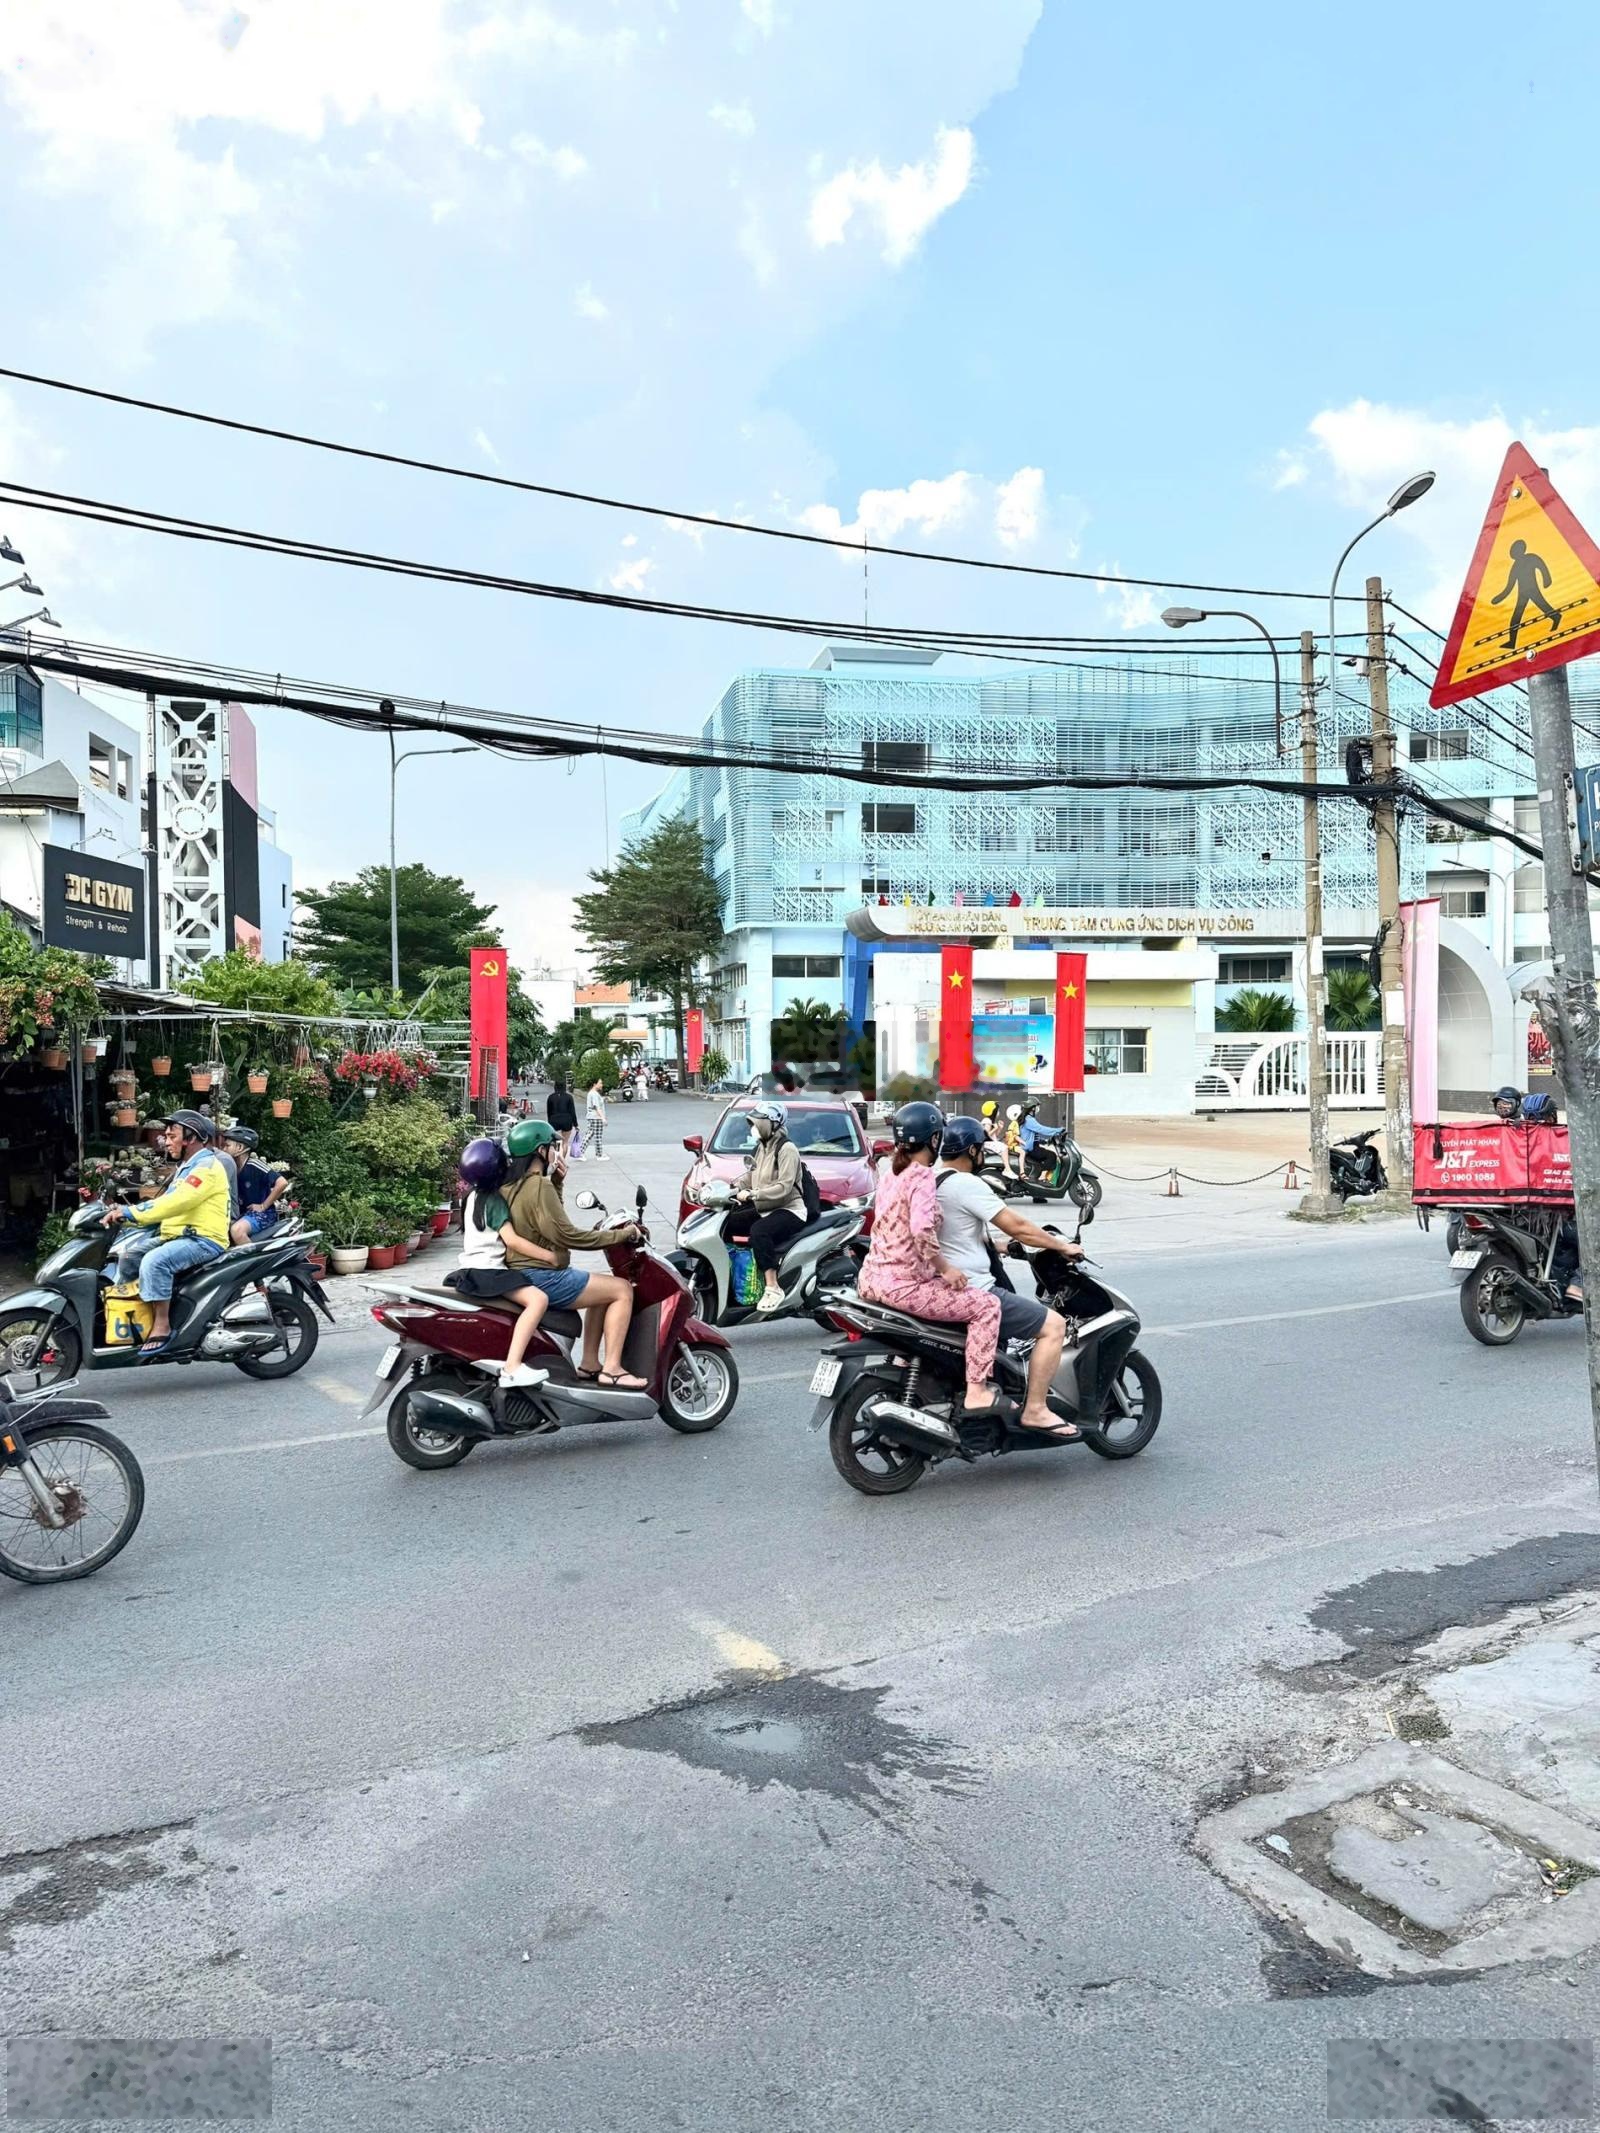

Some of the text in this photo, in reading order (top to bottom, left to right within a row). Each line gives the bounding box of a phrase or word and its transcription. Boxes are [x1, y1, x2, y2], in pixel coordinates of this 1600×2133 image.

[92, 880, 133, 913] GYM
[65, 915, 128, 934] Strength & Rehab
[1023, 914, 1254, 934] TRUNG TÂM CUNG ỨNG DỊCH VỤ CÔNG
[1434, 1150, 1478, 1169] J&T
